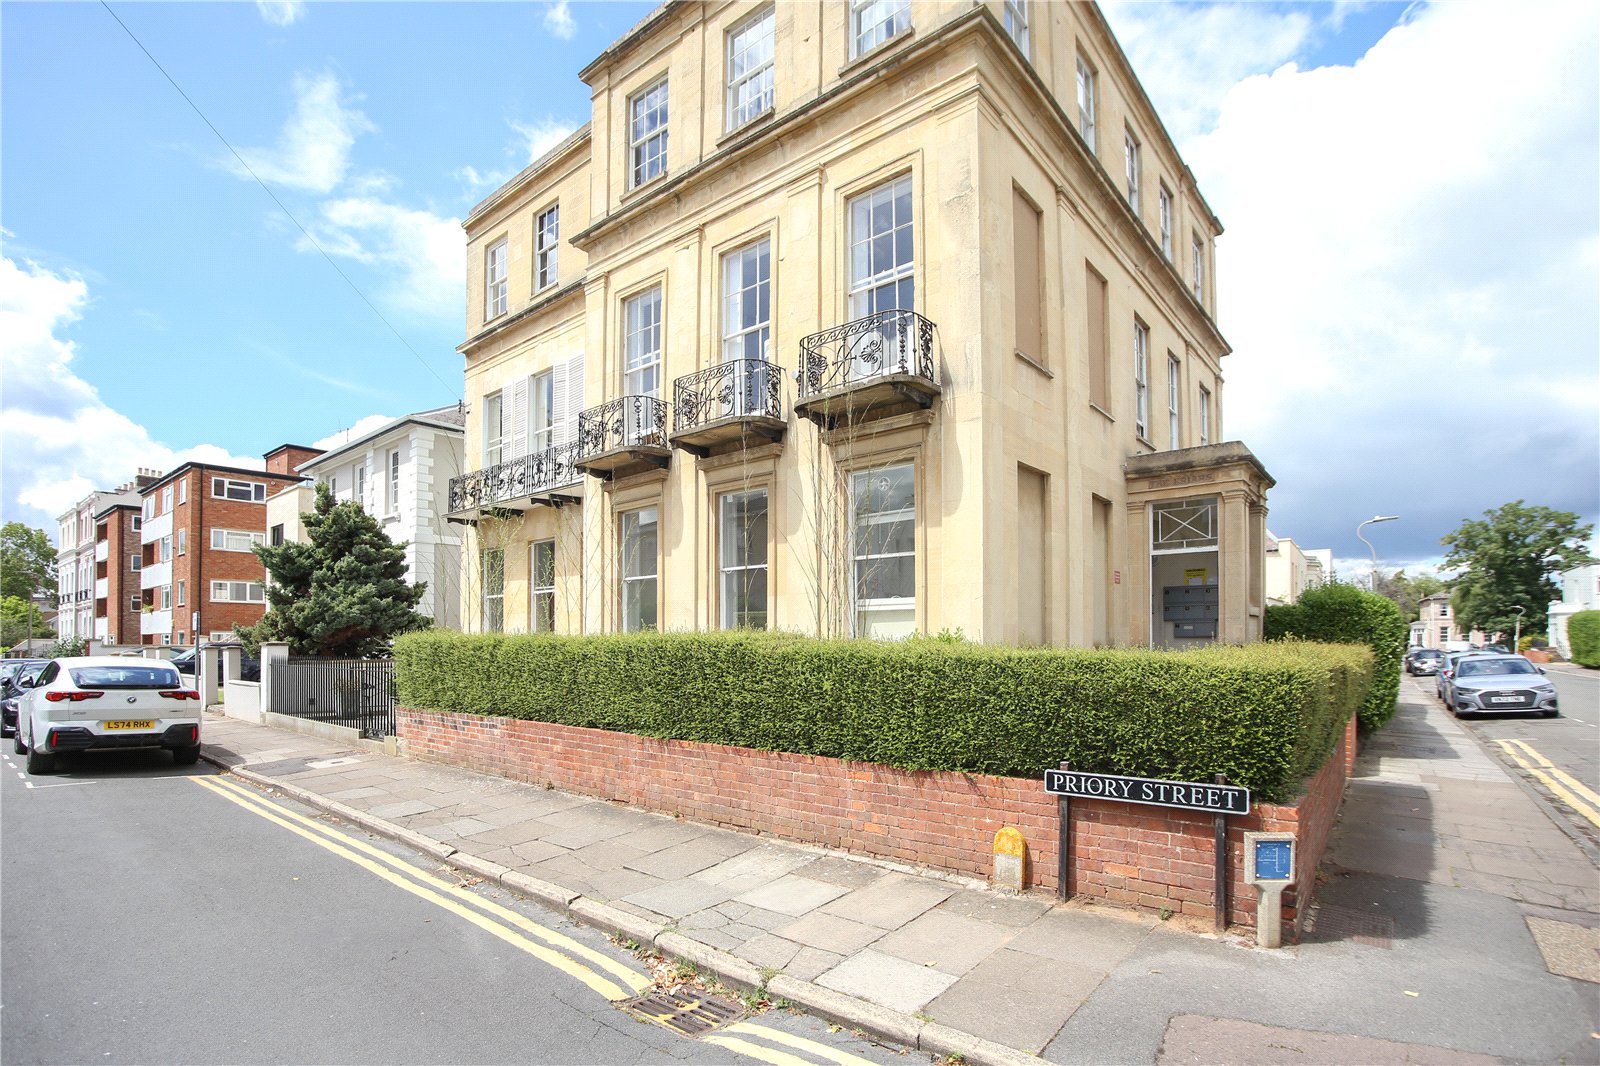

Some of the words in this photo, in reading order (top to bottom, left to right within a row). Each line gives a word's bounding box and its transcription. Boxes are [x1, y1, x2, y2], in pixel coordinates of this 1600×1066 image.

[107, 721, 131, 729] LS74
[133, 720, 151, 728] RHX
[1053, 774, 1134, 798] PRIORY
[1141, 782, 1239, 809] STREET
